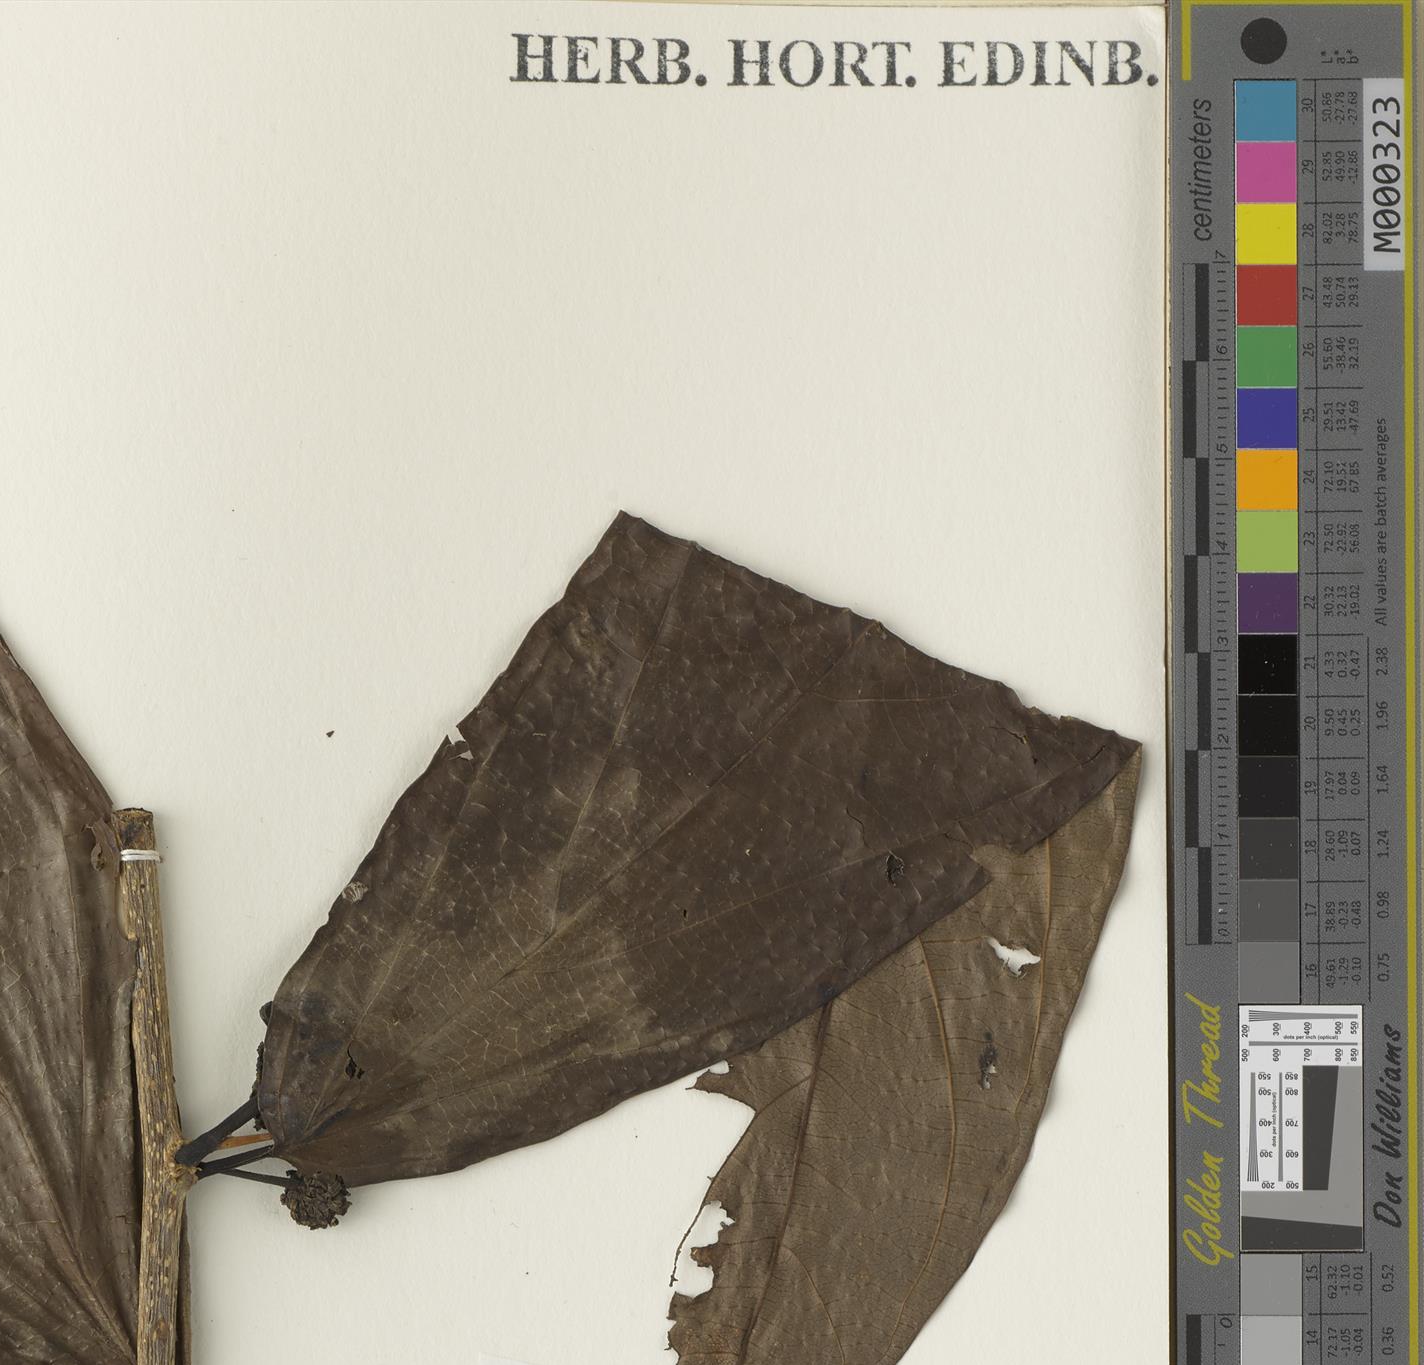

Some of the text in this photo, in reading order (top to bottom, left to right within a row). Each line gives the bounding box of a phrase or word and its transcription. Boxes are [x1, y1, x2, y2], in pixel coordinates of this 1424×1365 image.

[509, 33, 1159, 88] HERB. HORT. EDINB.
[1187, 98, 1213, 242] centimeters
[1373, 417, 1390, 627] All values are batch averages
[1375, 647, 1389, 677] 2.38
[1375, 700, 1389, 731] 1.96
[1375, 764, 1390, 795] 1.64
[1376, 828, 1390, 859] 1.24
[1375, 890, 1391, 920] 0.98
[1376, 952, 1391, 983] 0.75
[1180, 991, 1234, 1267] Golden Thread
[1370, 1023, 1404, 1229] Don Williams
[1380, 1264, 1395, 1293] 0.52
[1381, 1326, 1395, 1356] 0.36
